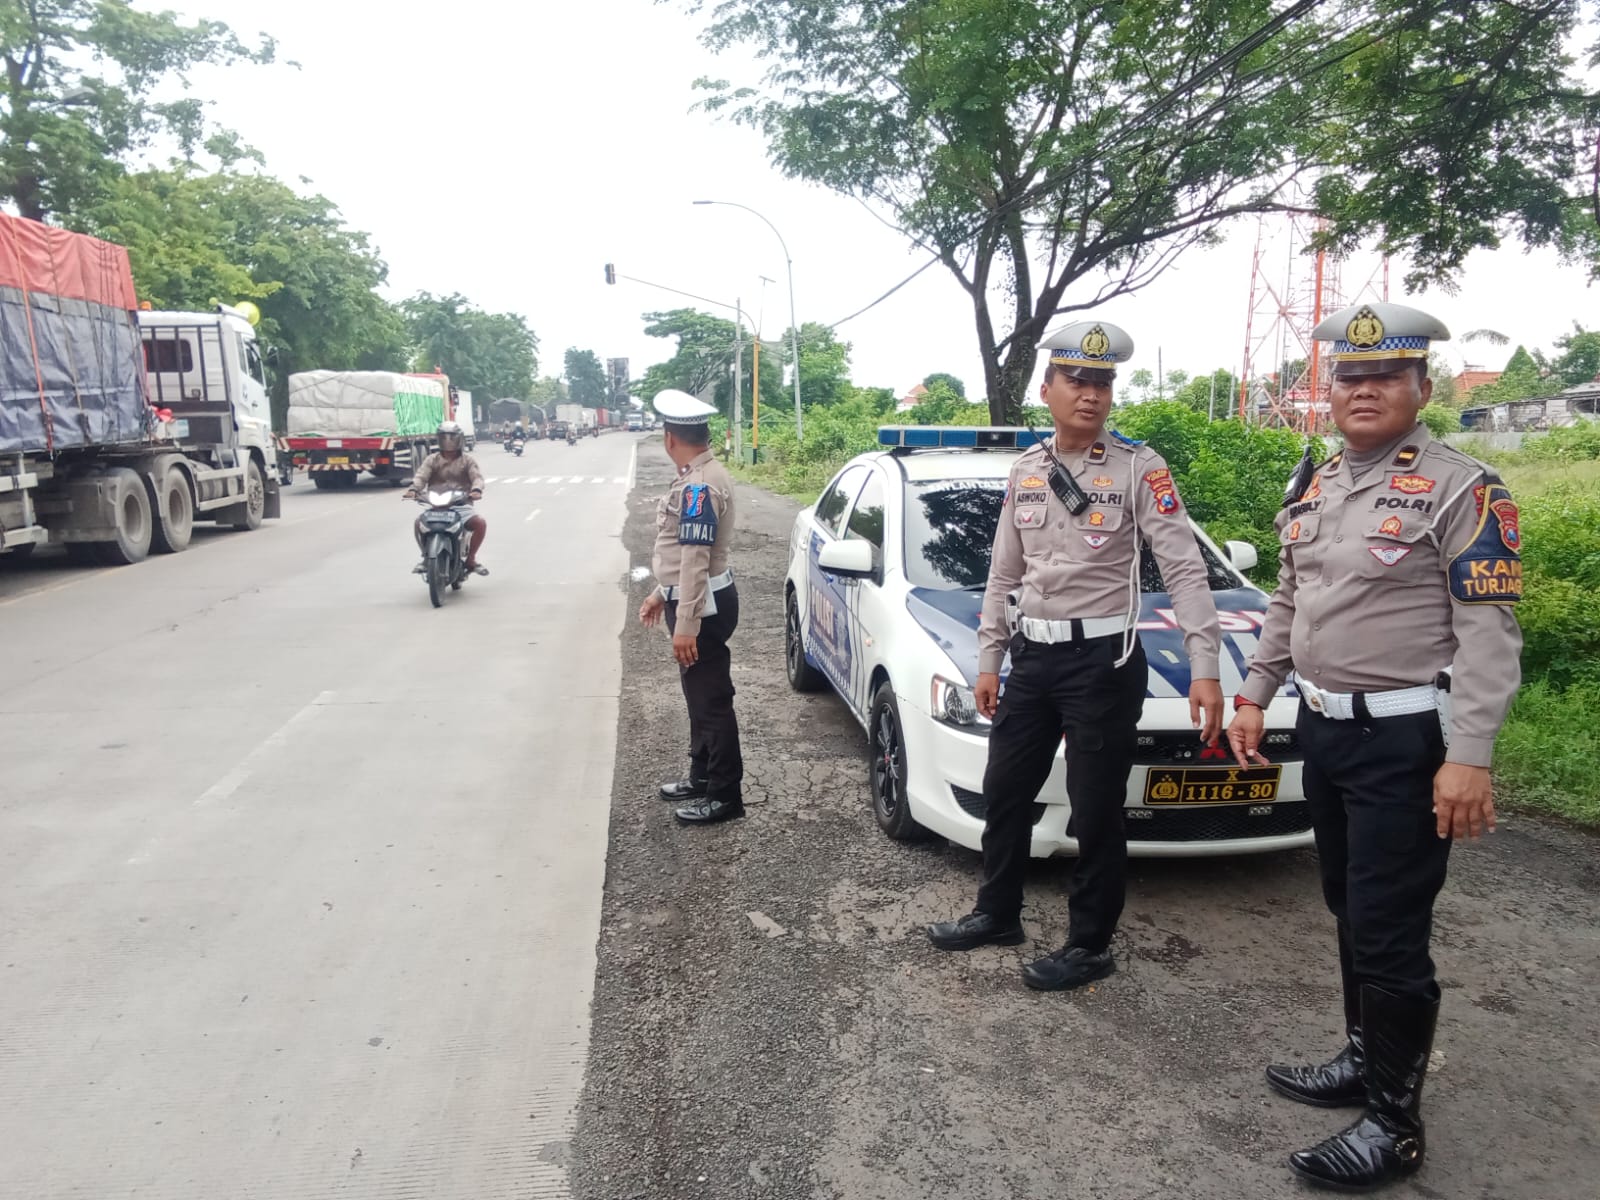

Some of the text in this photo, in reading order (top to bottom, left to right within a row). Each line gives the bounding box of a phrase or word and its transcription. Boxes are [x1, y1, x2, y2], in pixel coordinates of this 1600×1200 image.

[1086, 492, 1123, 505] OLRI
[1374, 497, 1433, 514] POLRI
[679, 523, 715, 541] ATWAL
[1185, 784, 1233, 801] 1116
[1249, 783, 1273, 798] 30
